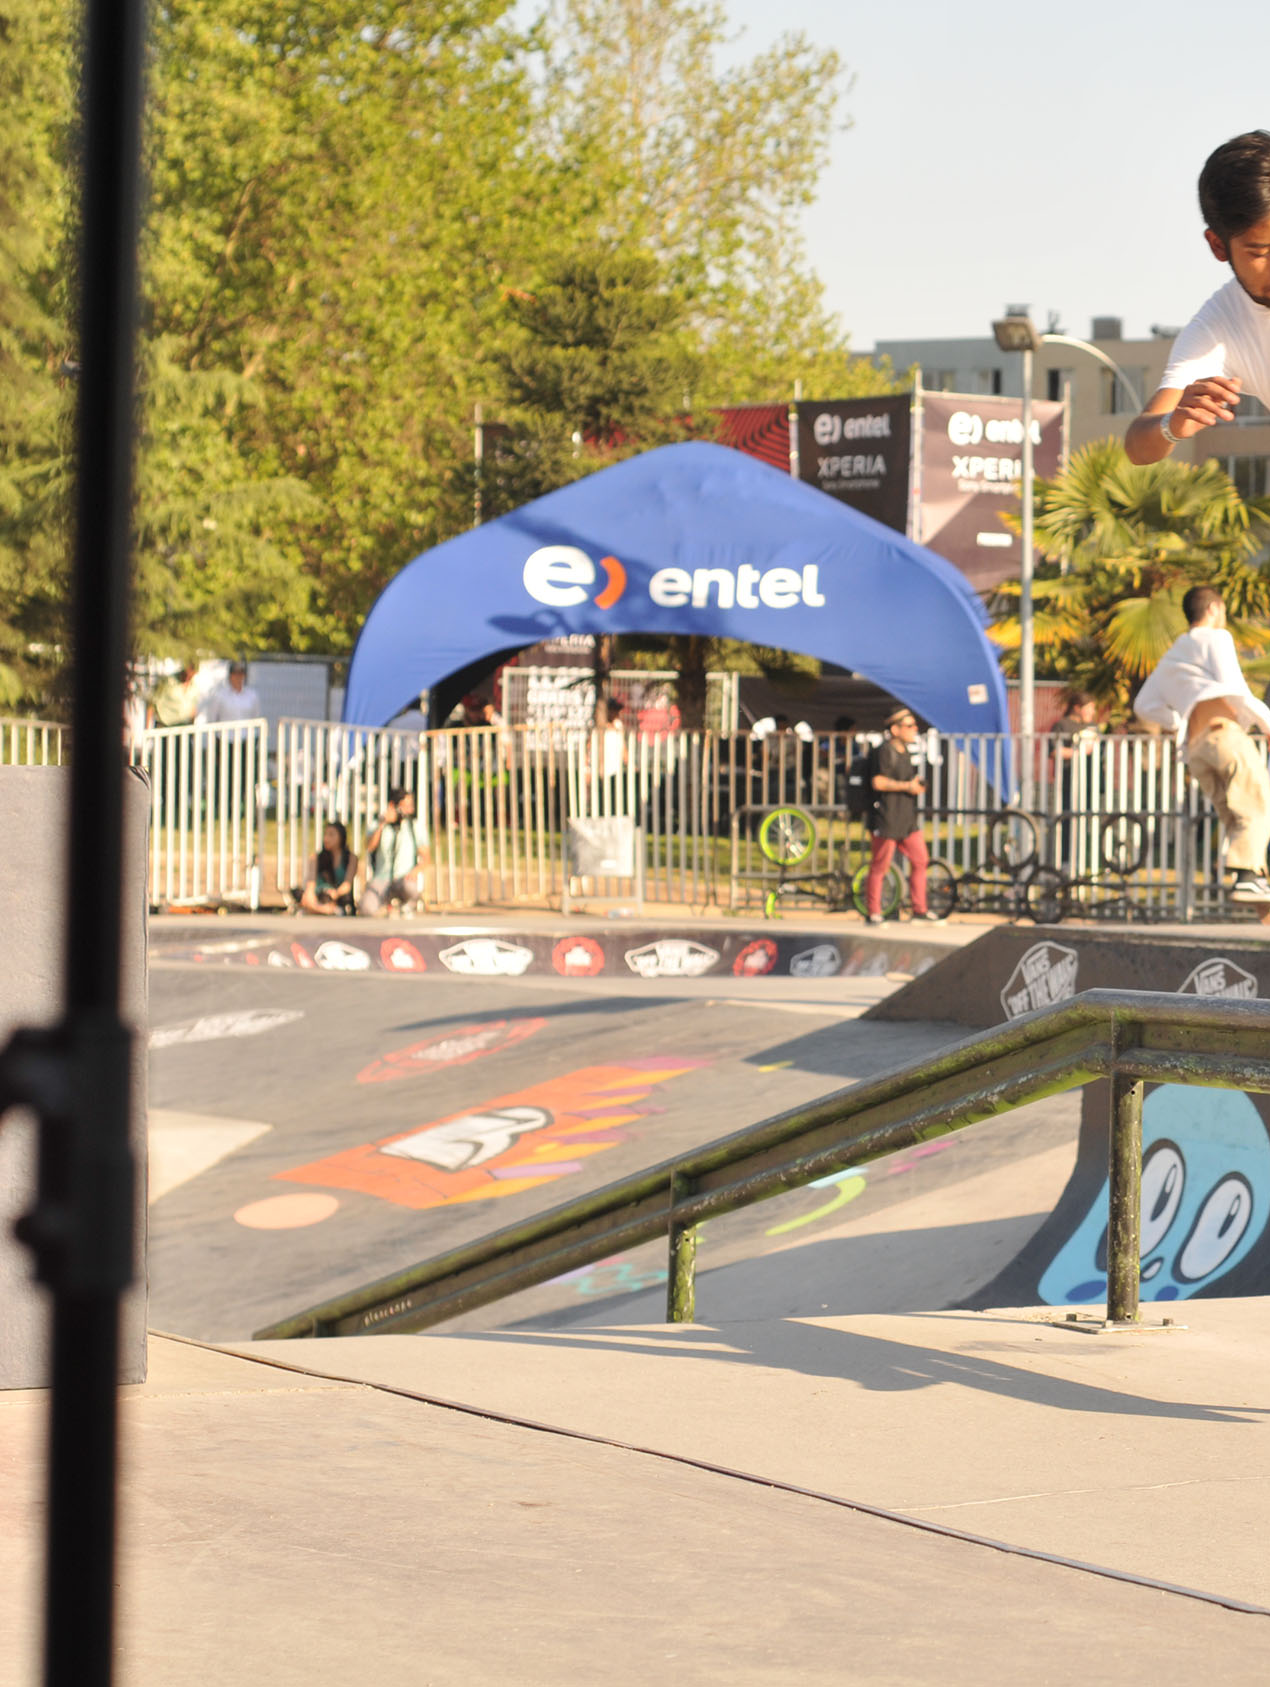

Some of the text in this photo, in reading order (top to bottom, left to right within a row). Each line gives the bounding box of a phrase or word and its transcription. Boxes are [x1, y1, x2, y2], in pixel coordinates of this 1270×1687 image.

[843, 414, 891, 440] entel
[985, 417, 1042, 445] entl
[818, 455, 886, 478] XPERIA
[952, 456, 1035, 481] XPERI
[649, 563, 826, 609] entel
[1020, 947, 1051, 984] VANS
